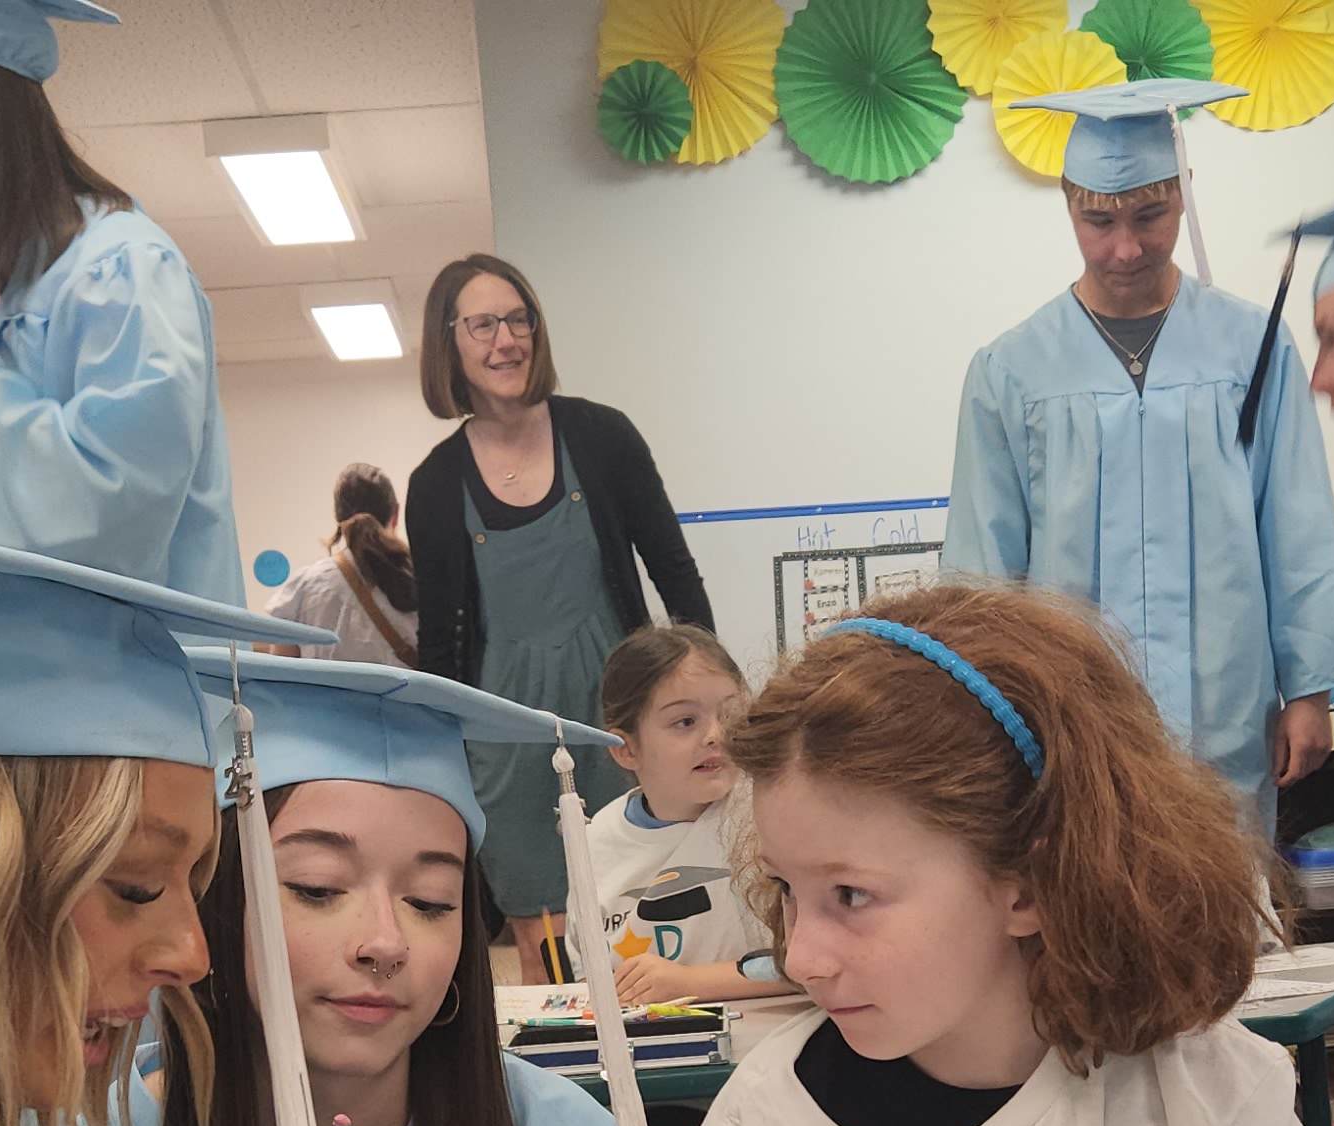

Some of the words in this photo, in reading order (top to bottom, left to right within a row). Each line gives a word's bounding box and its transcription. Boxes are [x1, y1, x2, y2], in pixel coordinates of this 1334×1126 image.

[796, 521, 836, 550] Hot
[872, 514, 921, 546] Cold
[817, 600, 837, 609] Enzo
